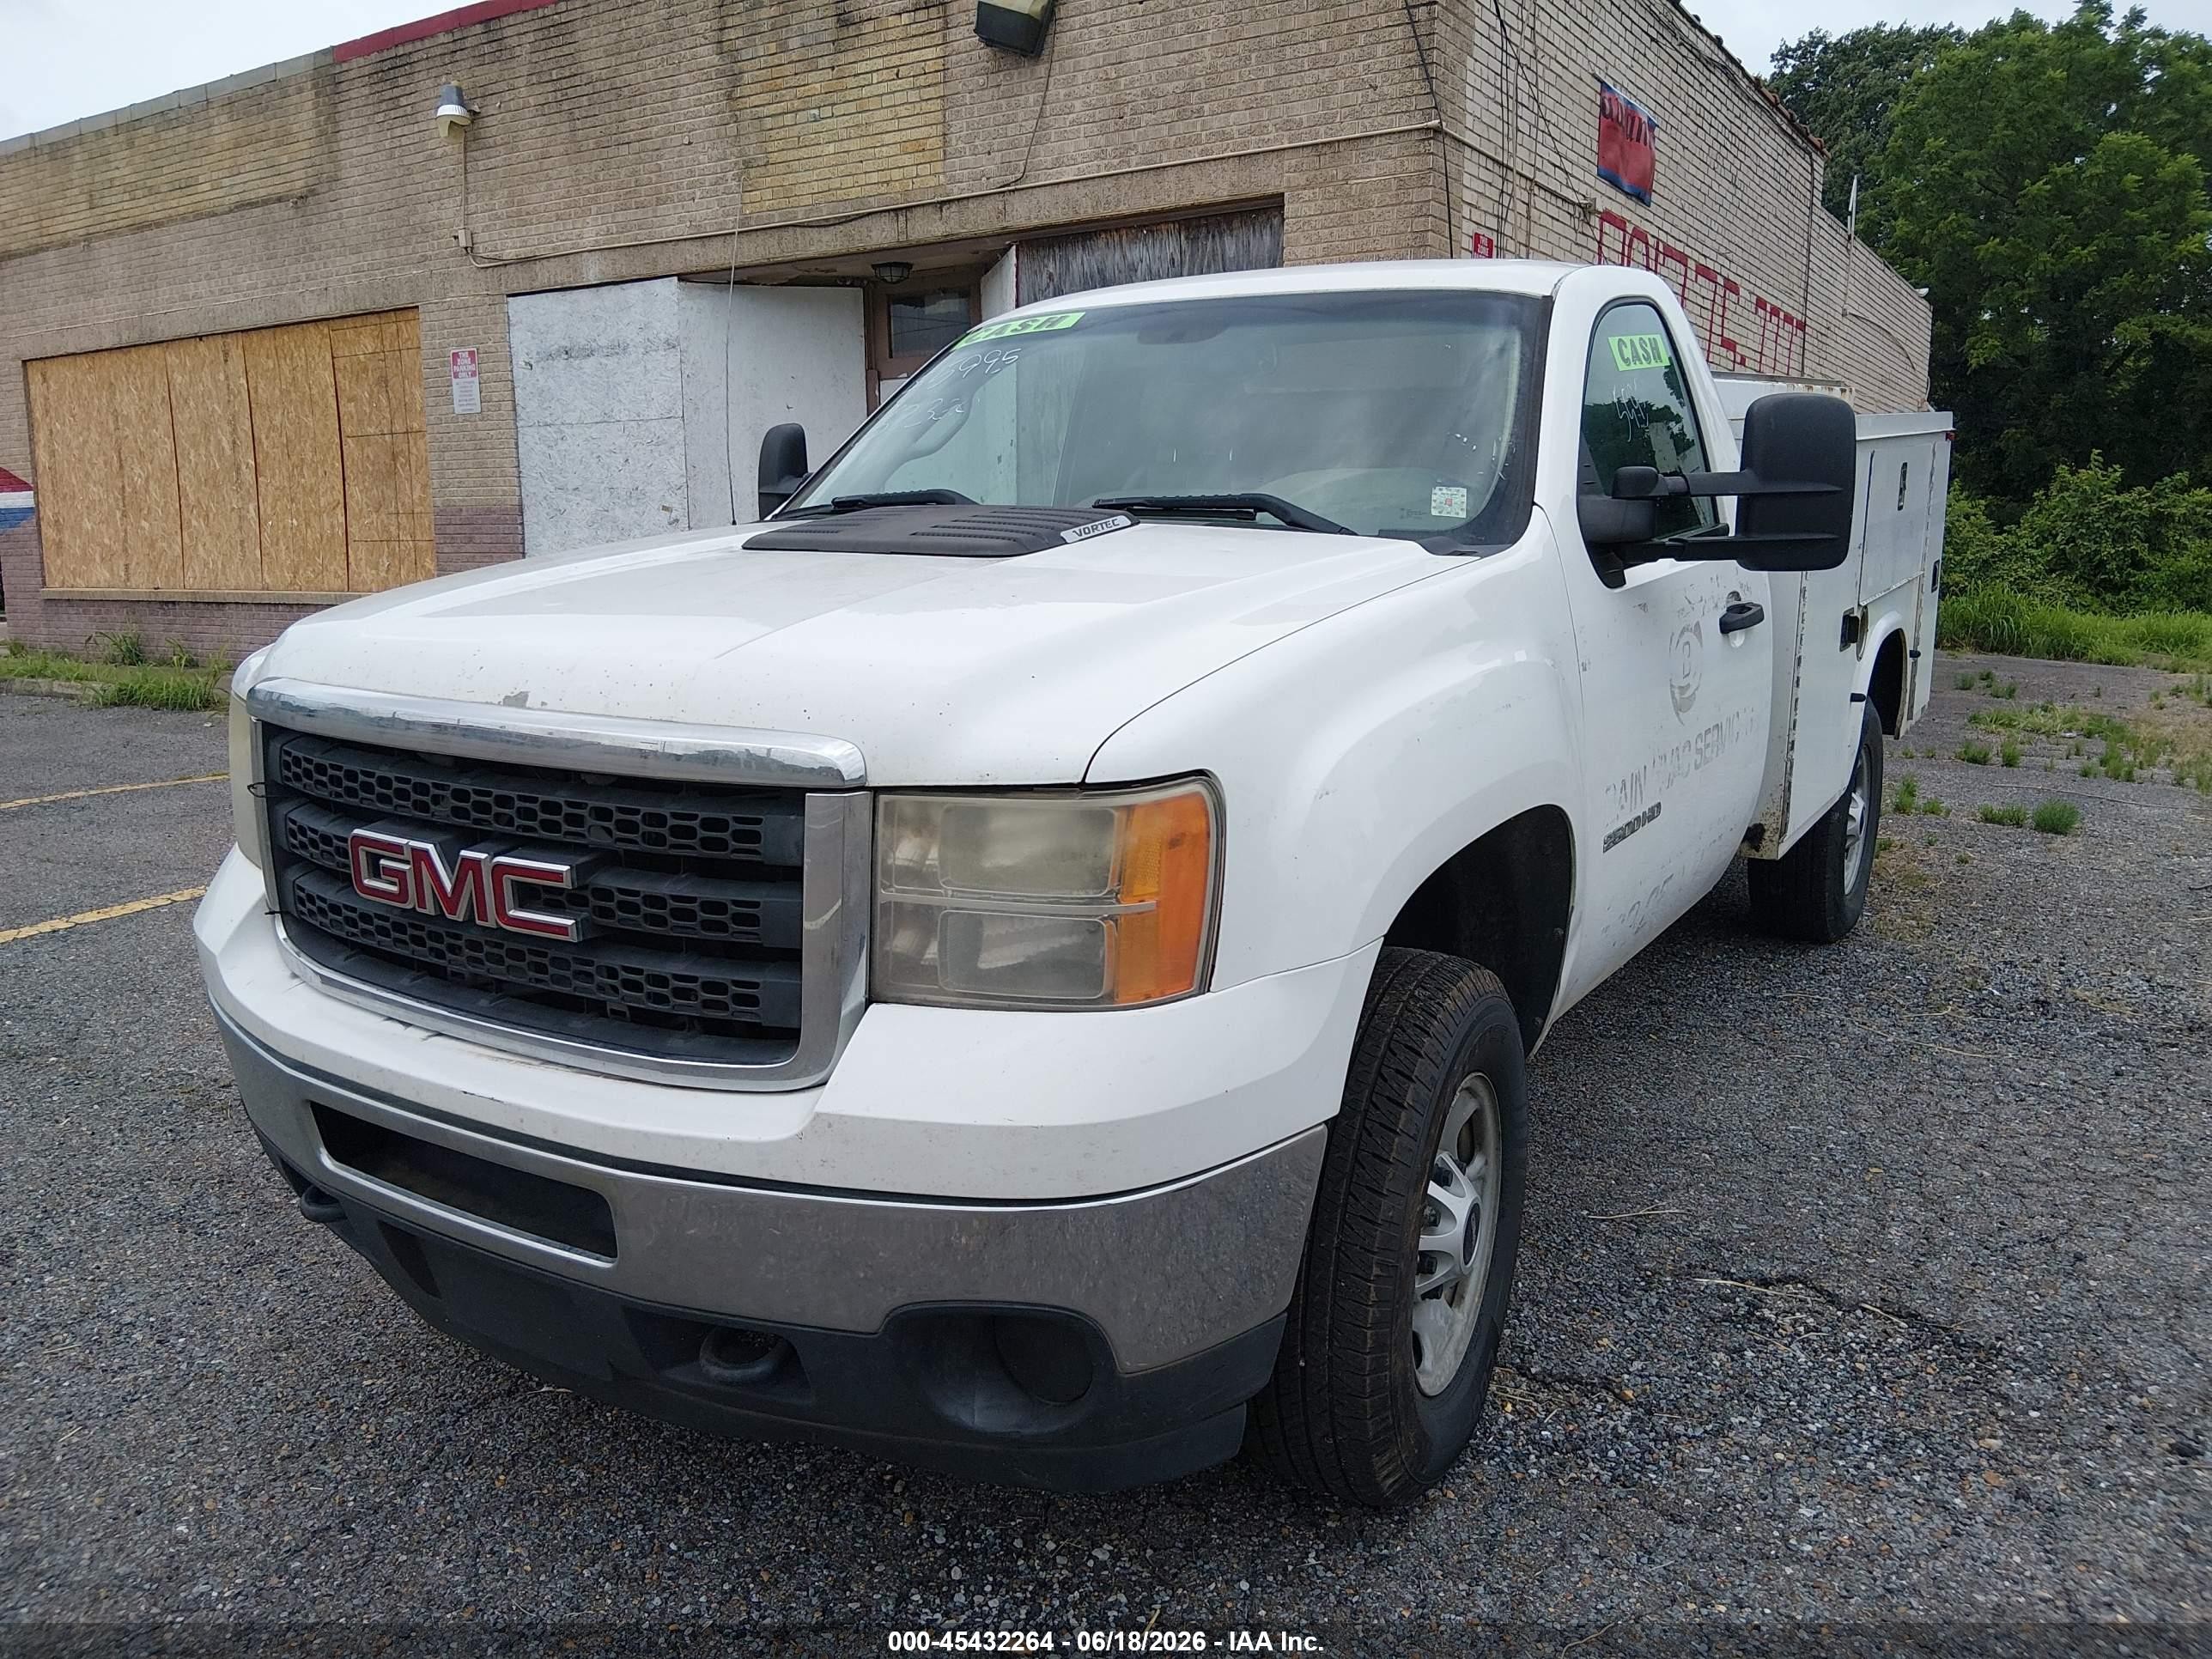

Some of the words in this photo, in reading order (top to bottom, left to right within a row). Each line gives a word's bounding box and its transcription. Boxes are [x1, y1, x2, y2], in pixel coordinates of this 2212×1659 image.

[1617, 336, 1663, 367] CASH
[1072, 519, 1121, 538] VORTEC
[348, 828, 580, 943] GMC
